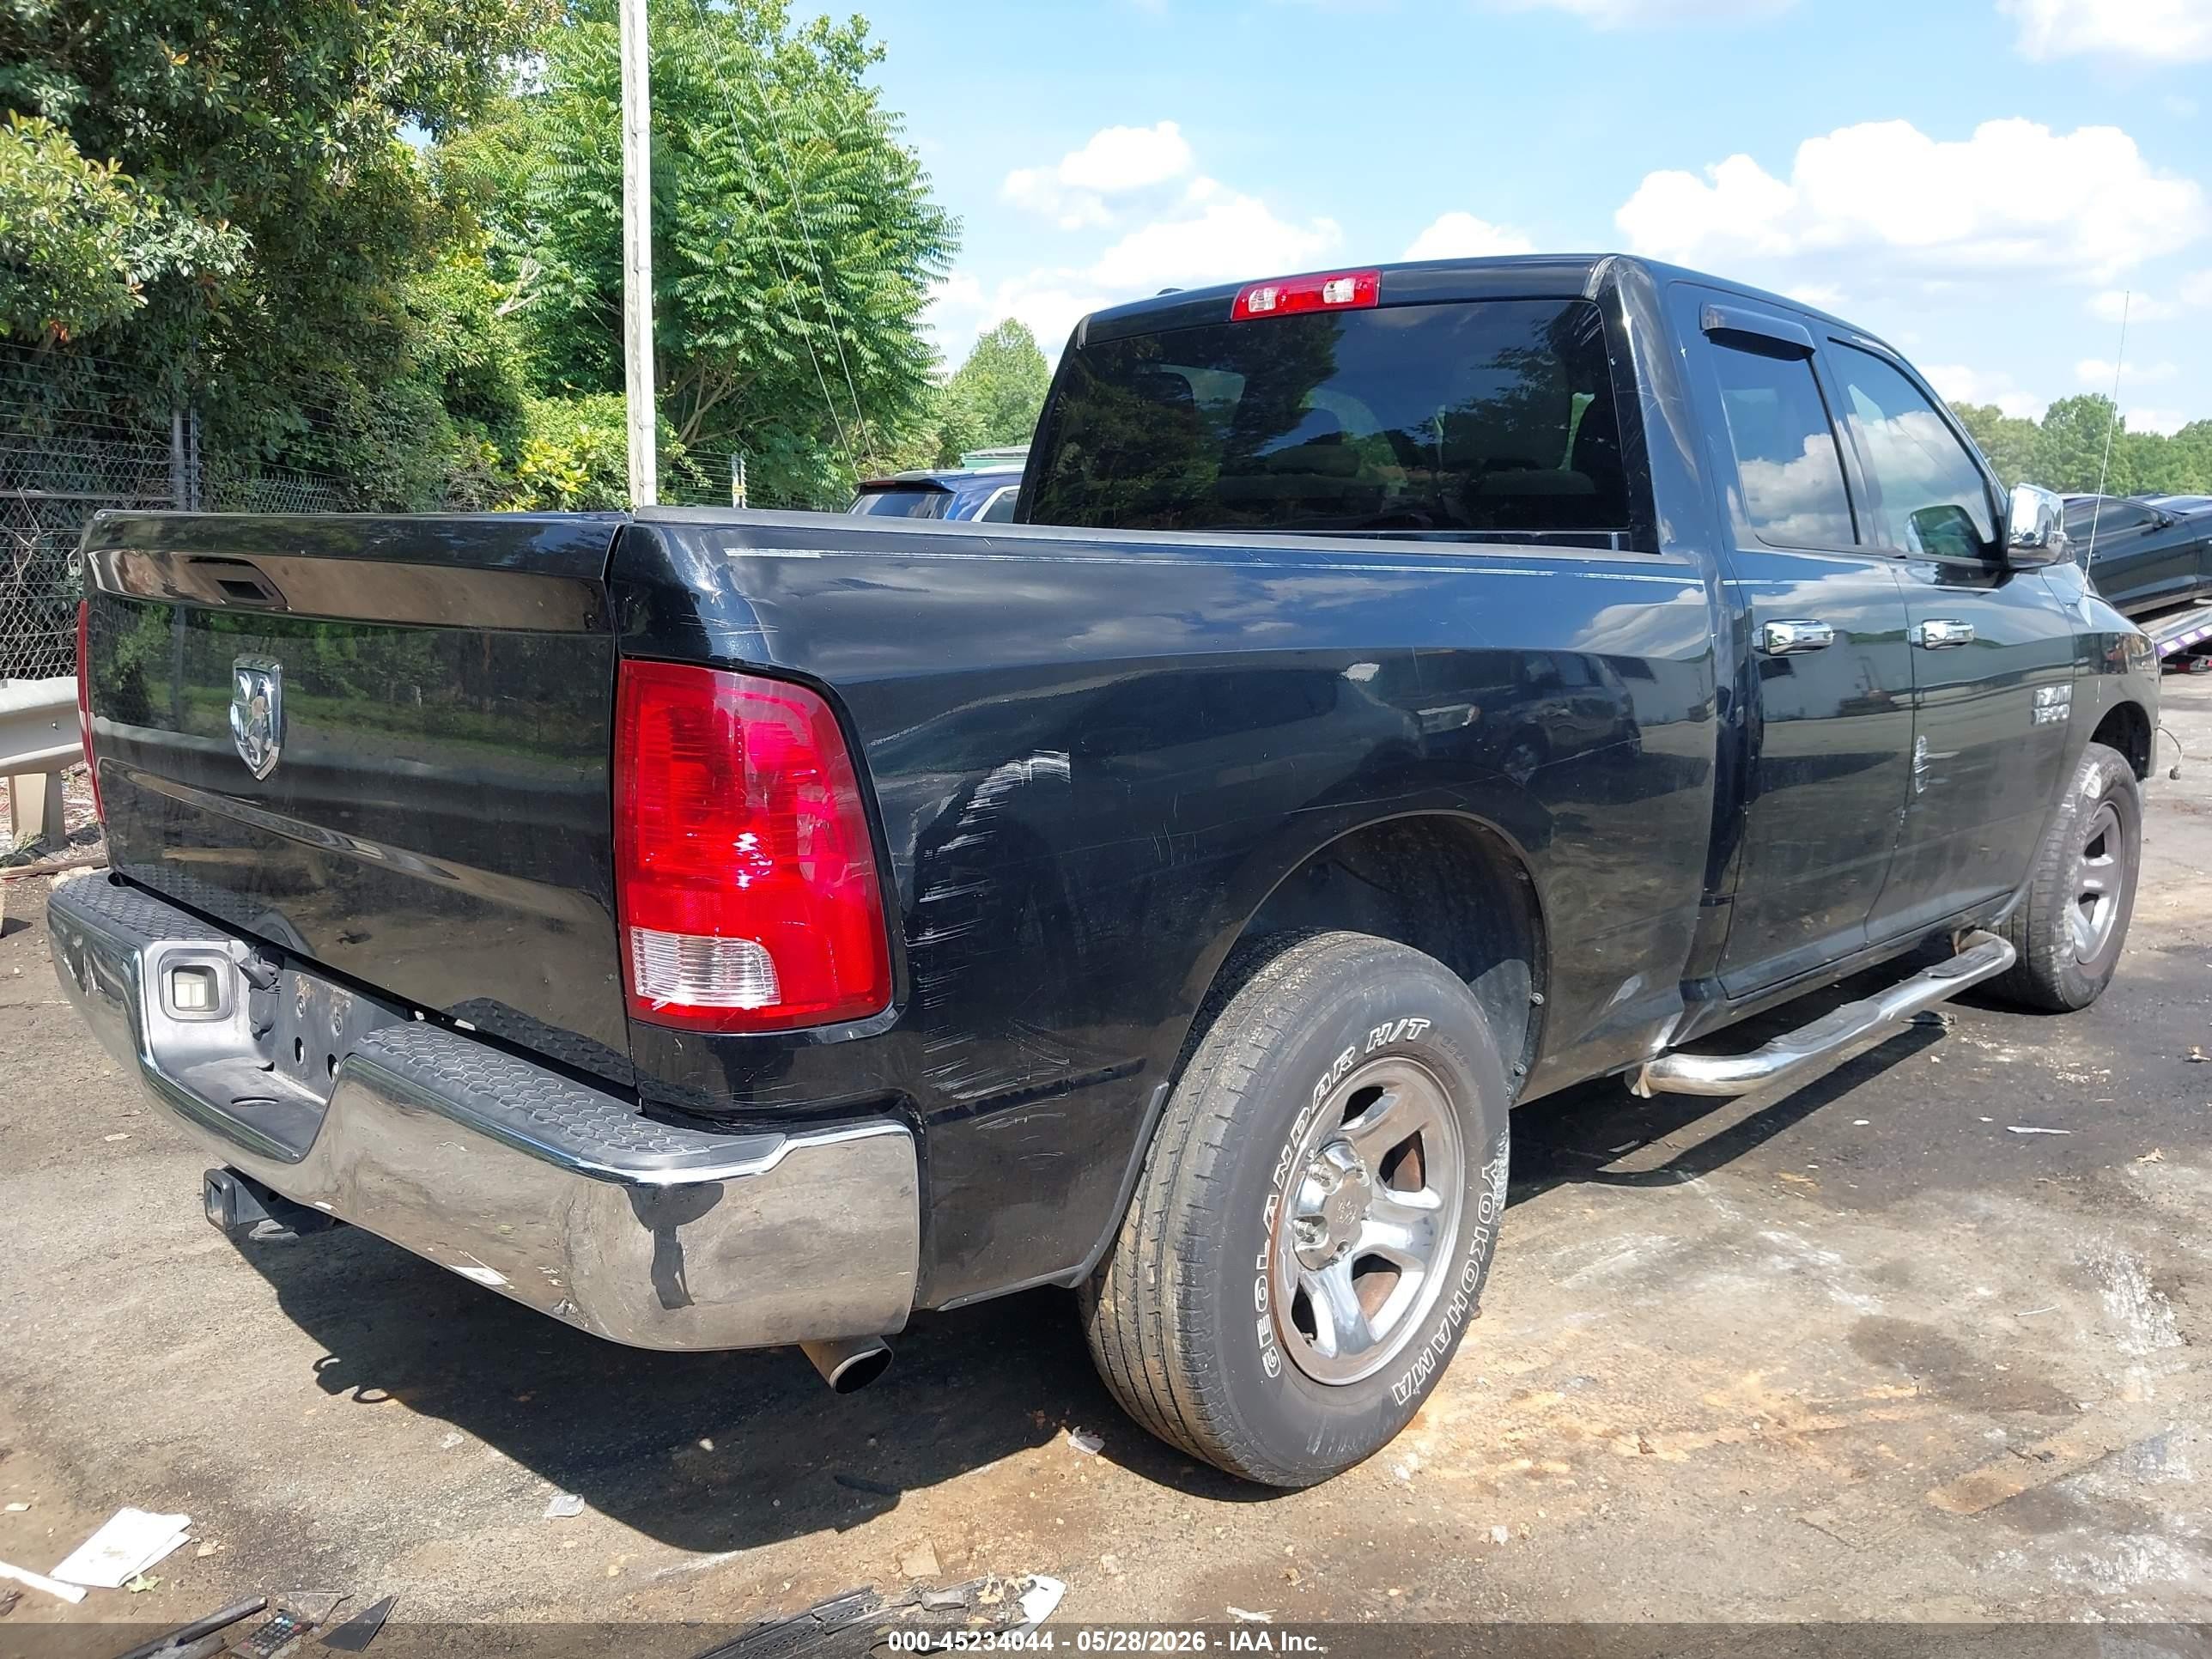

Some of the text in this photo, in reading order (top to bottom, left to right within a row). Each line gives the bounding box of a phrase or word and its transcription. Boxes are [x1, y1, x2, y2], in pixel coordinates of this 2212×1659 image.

[1254, 1018, 1431, 1378] GEOLANDAR H/T
[1391, 1158, 1498, 1407] YOKOHAMA
